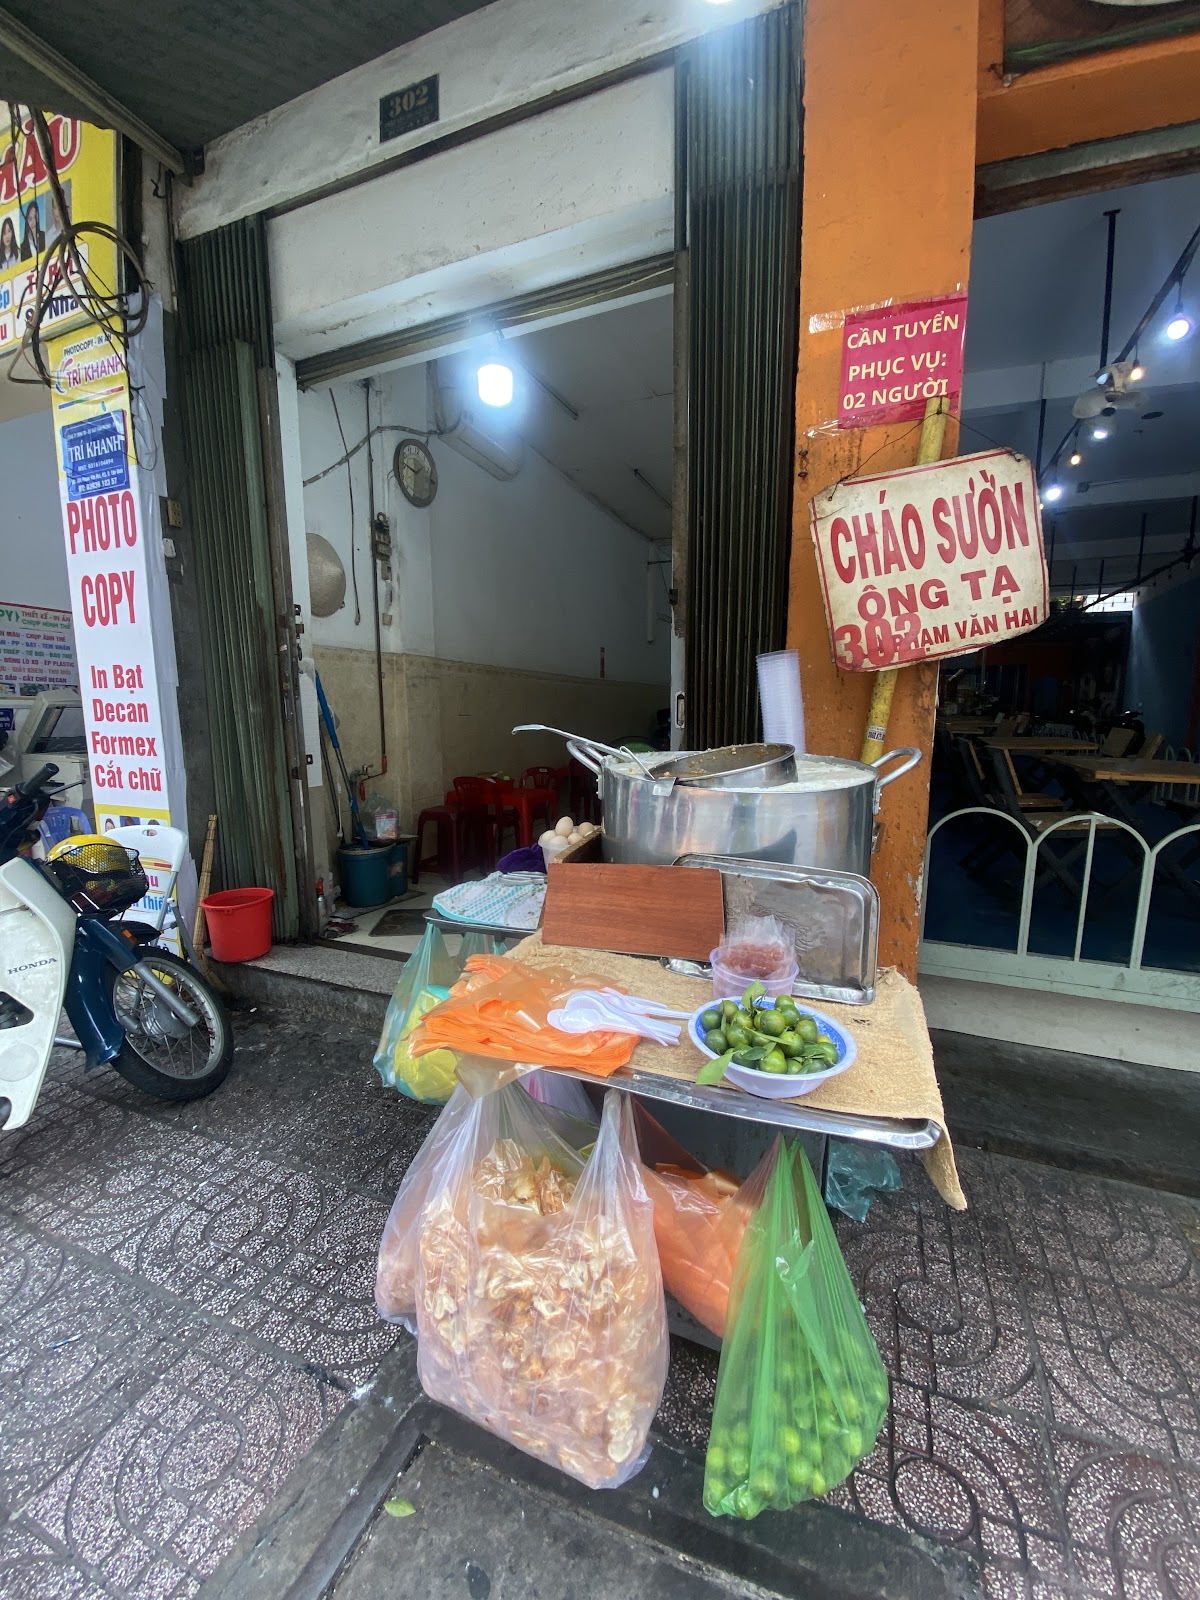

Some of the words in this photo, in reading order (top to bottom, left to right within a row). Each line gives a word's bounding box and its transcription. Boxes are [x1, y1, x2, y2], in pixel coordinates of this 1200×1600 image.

[389, 85, 429, 118] 302
[847, 327, 887, 349] CẦN
[892, 311, 959, 341] TUYỂN
[63, 339, 94, 356] PHOTOCOPY
[66, 363, 82, 388] TRÍ
[84, 353, 124, 382] KHANH
[848, 357, 905, 382] PHỤC
[911, 350, 947, 373] VỤ:
[843, 392, 866, 410] 02
[872, 377, 949, 406] NGƯỜI
[68, 439, 85, 463] TRÍ
[86, 434, 122, 459] KHANH
[66, 490, 137, 554] PHOTO
[830, 489, 926, 584] CHÁO
[932, 469, 1030, 564] SƯỜN
[81, 570, 136, 627] COPY
[857, 578, 950, 622] ÔNG
[960, 564, 1021, 604] TẠ
[833, 612, 927, 669] 302
[955, 613, 998, 639] VĂN
[1004, 606, 1038, 629] HAI
[90, 665, 108, 689] In
[112, 664, 144, 694] Bạt
[92, 698, 149, 723] Decan
[91, 731, 158, 757] Formex
[94, 759, 124, 789] Cắt
[128, 767, 162, 791] chữ
[7, 957, 58, 975] HONDA
